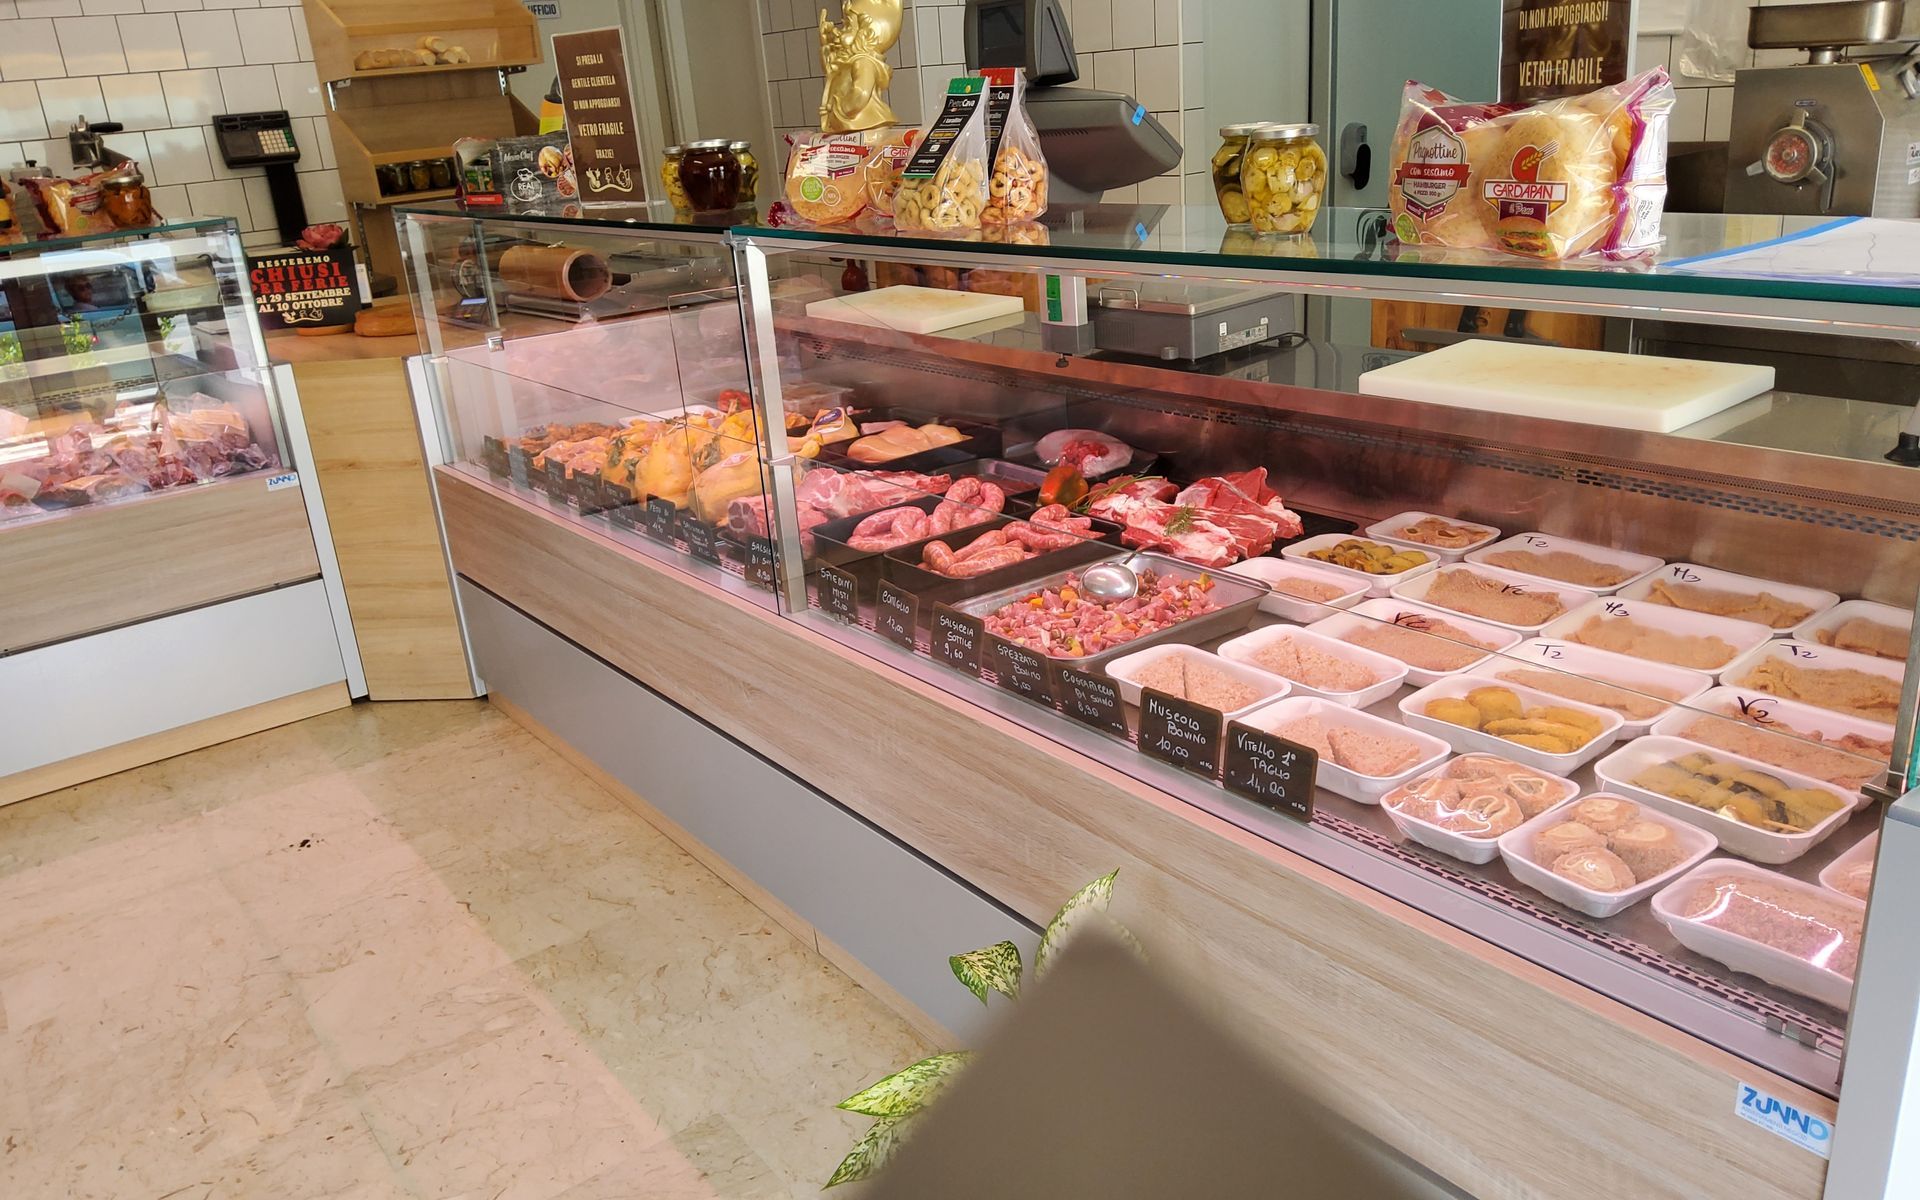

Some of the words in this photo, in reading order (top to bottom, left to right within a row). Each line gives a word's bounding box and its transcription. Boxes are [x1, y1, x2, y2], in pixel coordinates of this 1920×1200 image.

[1519, 11, 1528, 31] DI
[1529, 8, 1546, 29] NON
[581, 54, 597, 65] PREGA
[596, 53, 604, 64] LA
[1520, 59, 1553, 87] VETRO
[1555, 56, 1604, 86] FRAGILE
[571, 77, 591, 89] GENTILE
[590, 75, 616, 87] CLIENTELA
[579, 98, 590, 109] NON
[578, 122, 599, 137] VETRO
[598, 121, 625, 136] FRAGILE
[1412, 141, 1459, 163] Pagnottine
[1423, 167, 1455, 177] sesamo
[1493, 184, 1553, 199] GARDAPAN
[257, 255, 331, 269] RESTEREMO
[250, 262, 341, 284] CHIUSI
[290, 275, 349, 292] FERIE
[269, 293, 283, 303] 29
[284, 287, 351, 301] SETTEMBRE
[258, 302, 275, 313] AL
[276, 302, 290, 311] 10
[291, 297, 344, 310] OTTOBRE
[820, 567, 853, 592] SPIEDINI
[832, 587, 849, 601] MISTI
[882, 590, 910, 614] CONIGLIO
[886, 615, 904, 634] 12,00
[939, 614, 974, 638] SALSICCIA
[947, 631, 972, 650] SOTTILE
[944, 642, 964, 660] 9,60
[997, 644, 1038, 667] SPEZZATO
[1167, 720, 1206, 745] BOVINO
[1156, 735, 1189, 758] 10,00
[1249, 756, 1291, 781] TAGLIO
[1246, 772, 1286, 799] 14,00
[1742, 1086, 1829, 1141] ZUNNO
